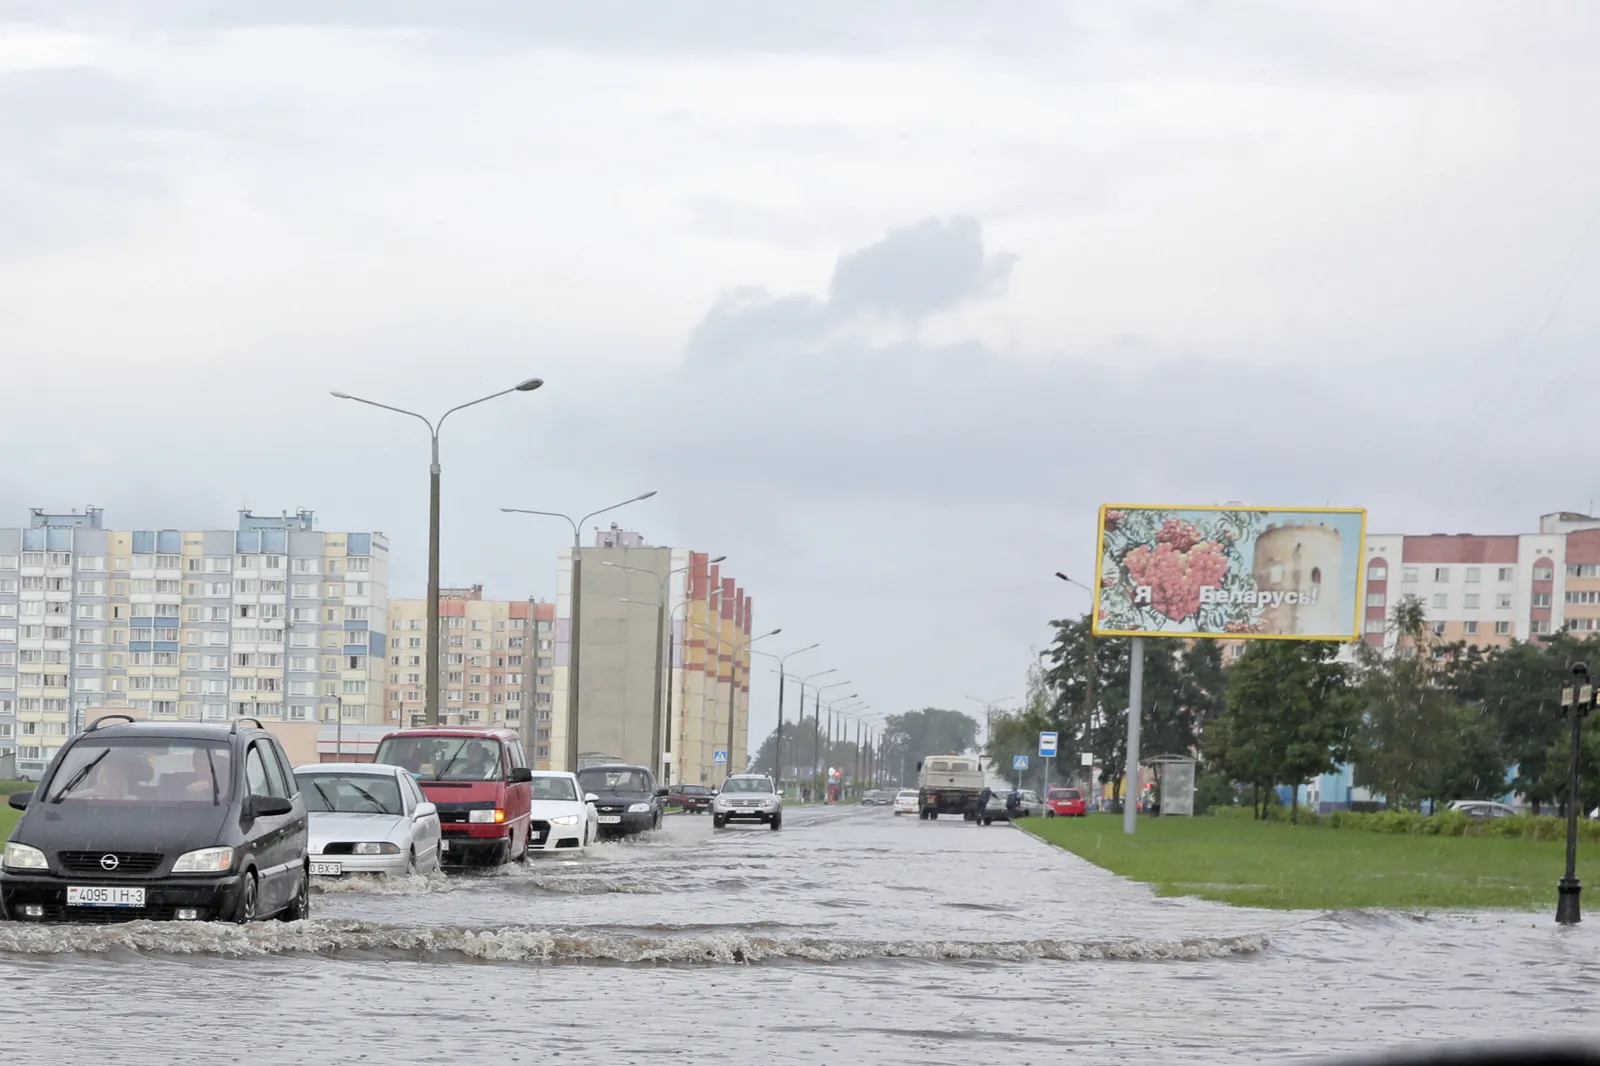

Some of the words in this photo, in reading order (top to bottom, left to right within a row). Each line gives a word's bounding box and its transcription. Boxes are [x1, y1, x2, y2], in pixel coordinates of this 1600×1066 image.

[1135, 585, 1151, 603] Я
[1199, 585, 1317, 610] Беларусь!
[318, 864, 340, 874] BX-3
[79, 888, 108, 902] 4095
